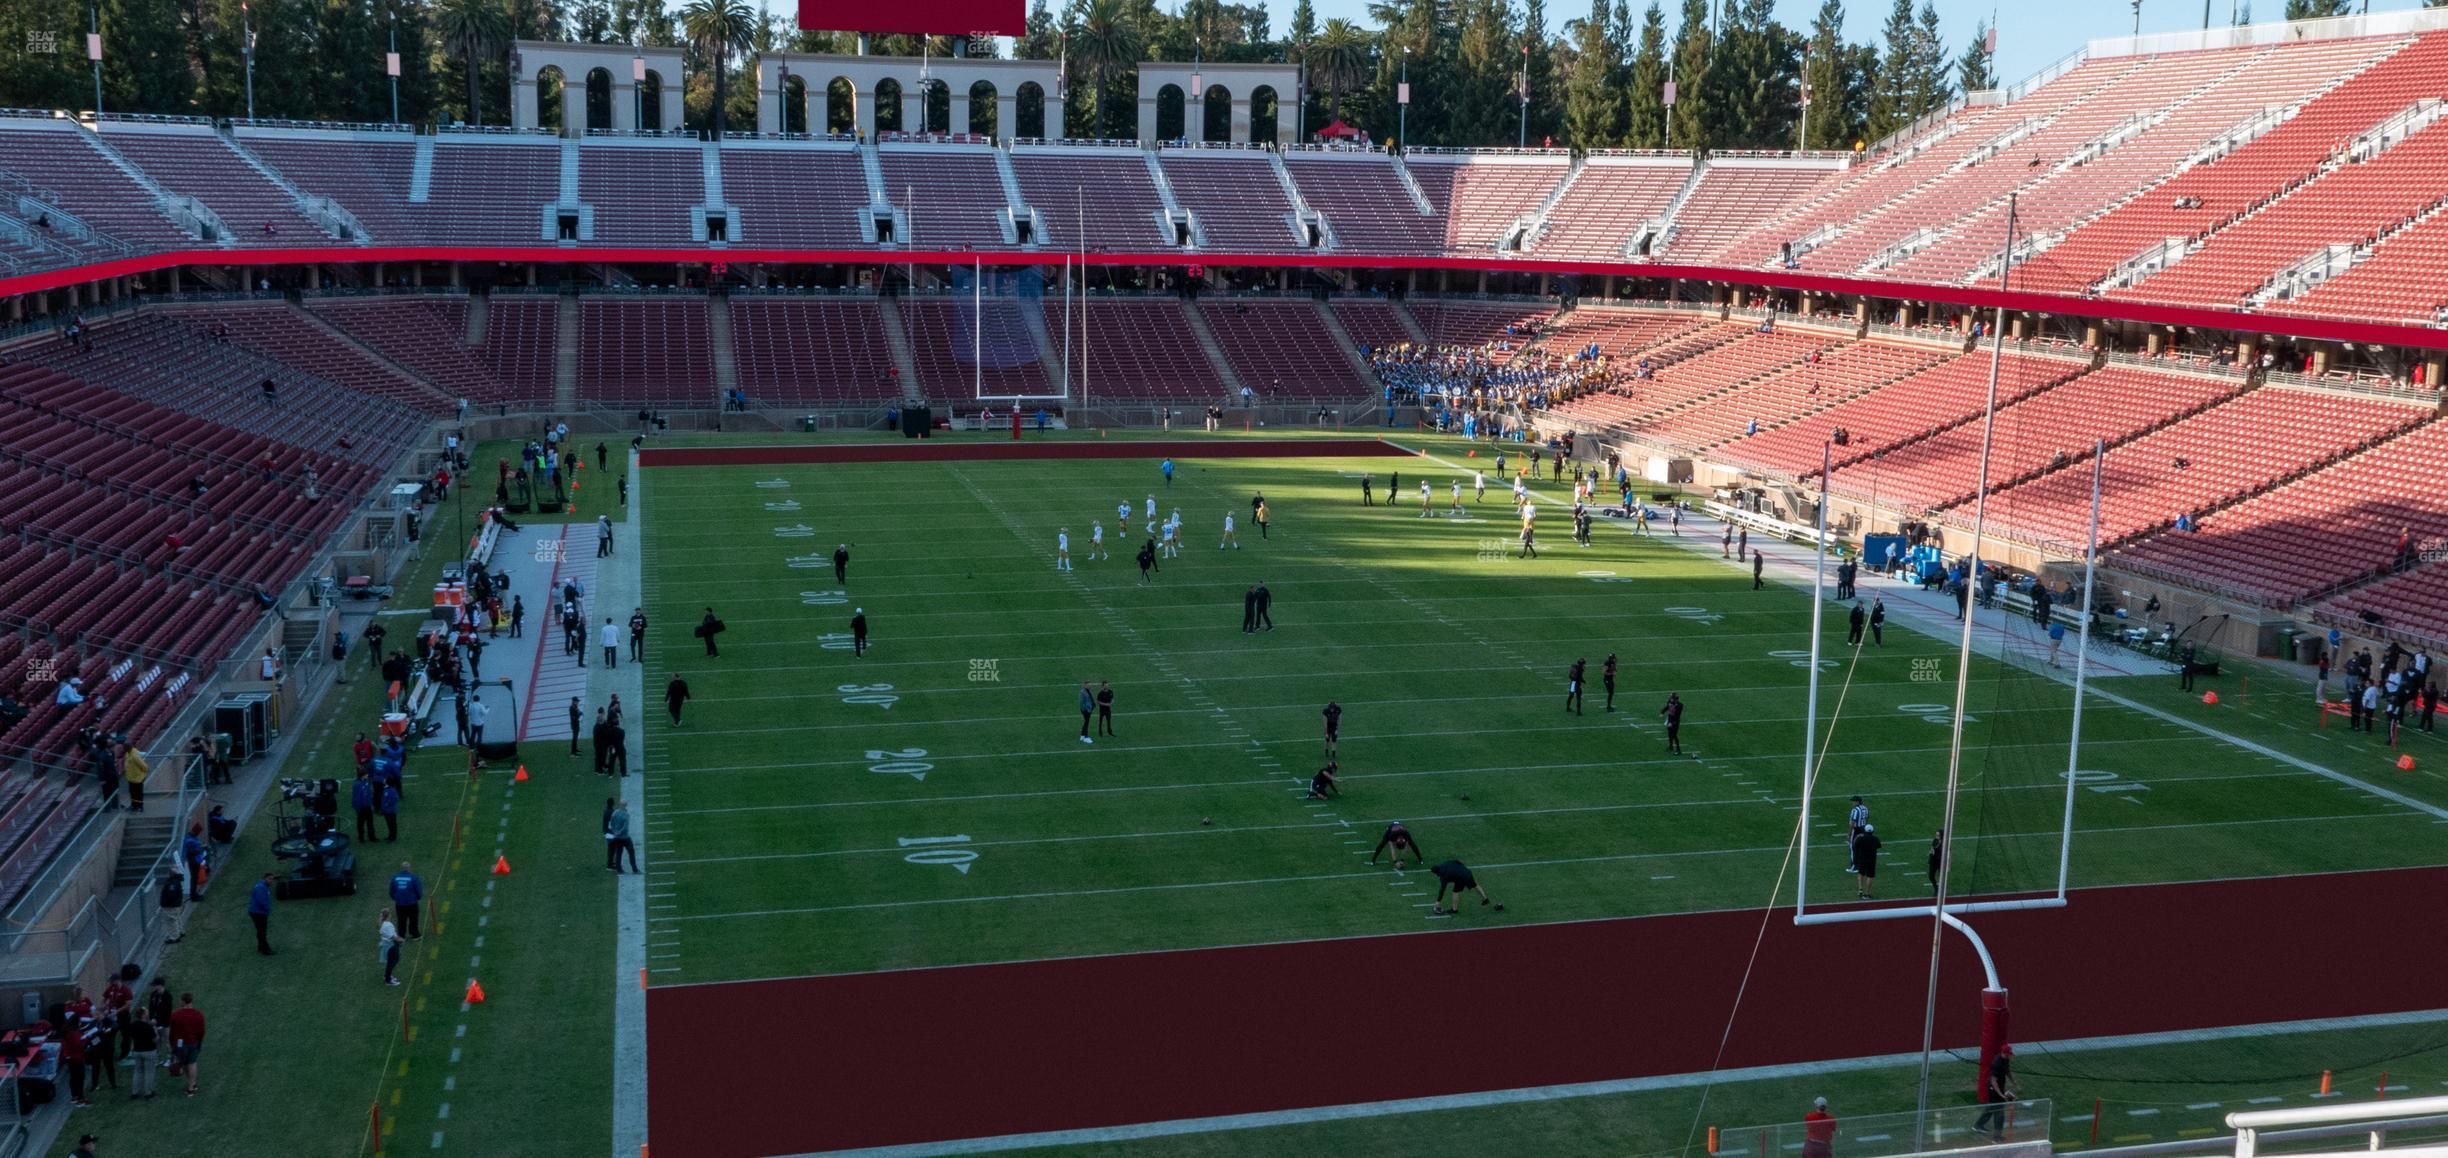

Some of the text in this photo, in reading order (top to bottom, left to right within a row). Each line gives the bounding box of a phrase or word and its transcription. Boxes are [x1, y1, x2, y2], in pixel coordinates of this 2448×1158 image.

[837, 683, 899, 704] 30
[863, 747, 935, 774] 20
[896, 833, 980, 864] 10
